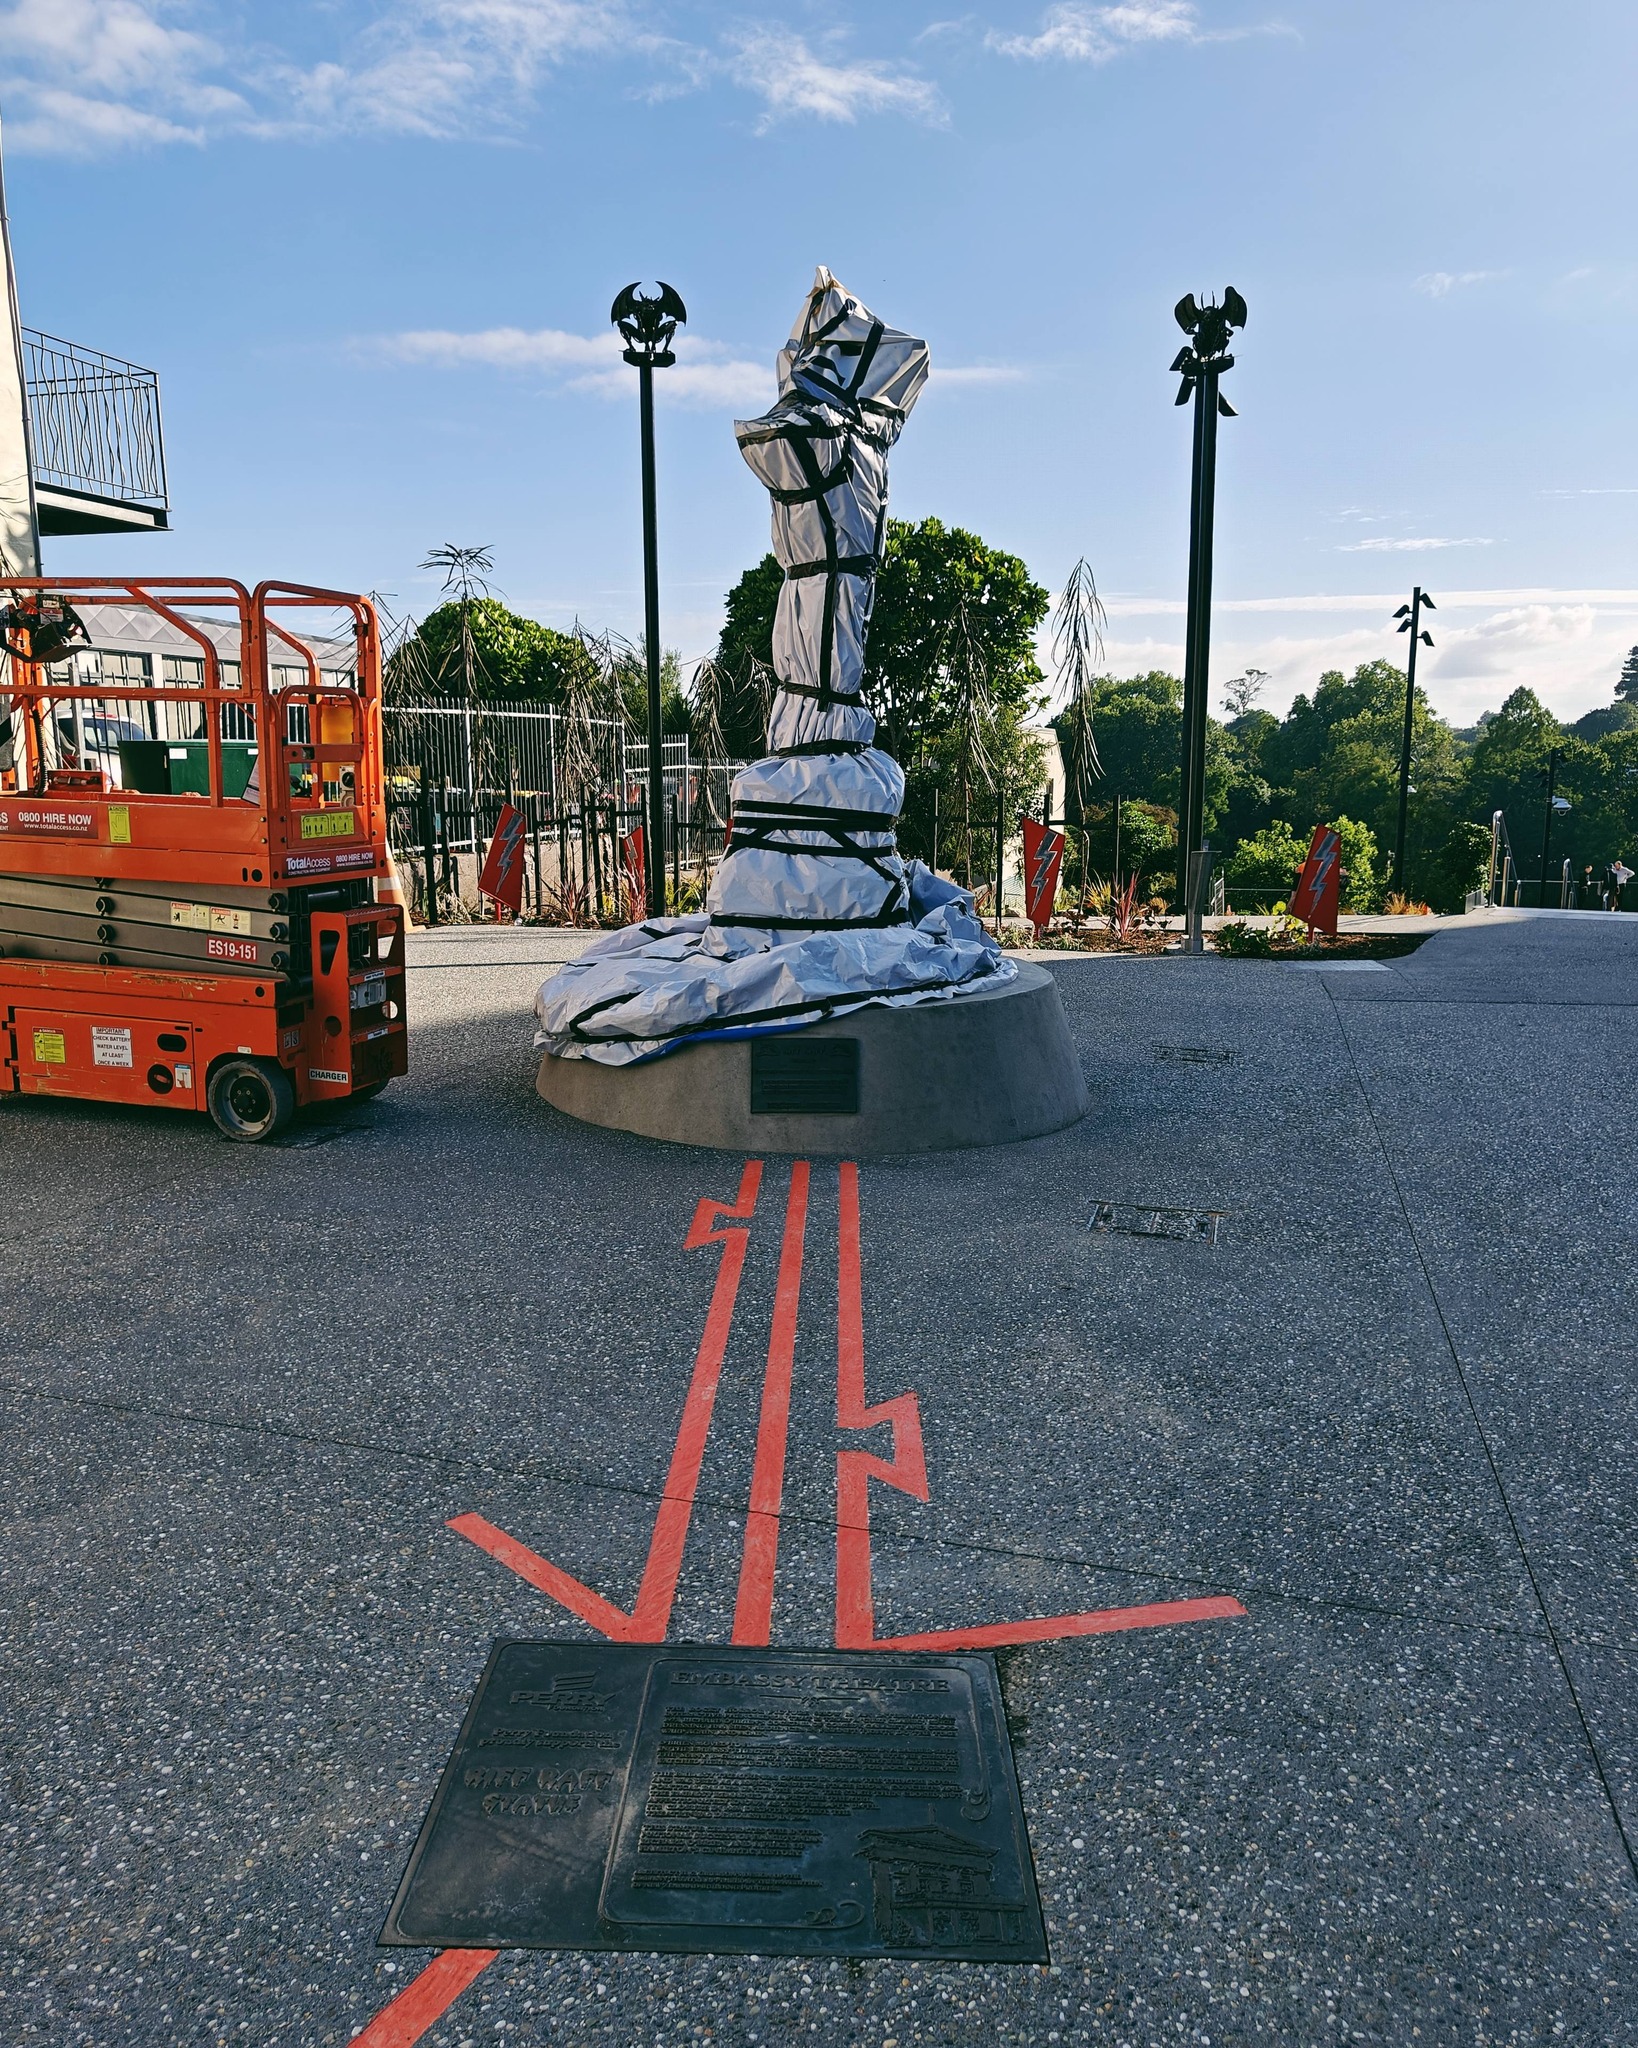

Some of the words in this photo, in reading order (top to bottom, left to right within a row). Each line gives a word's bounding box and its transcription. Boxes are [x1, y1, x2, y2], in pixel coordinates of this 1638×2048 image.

[18, 811, 40, 822] 0800
[42, 813, 66, 823] HIRE
[68, 814, 92, 825] NOW
[24, 822, 88, 832] www.totalaccess.co.nz
[348, 853, 361, 862] HIRE
[361, 852, 374, 860] NOW
[208, 939, 256, 960] ES19-151
[310, 1070, 347, 1081] CHARGER
[671, 1671, 808, 1689] EMBASSY
[811, 1676, 951, 1692] THEATRE
[510, 1690, 617, 1707] PERRY
[492, 1727, 532, 1738] Perry
[534, 1728, 613, 1740] Foundation
[464, 1766, 533, 1789] RIFF
[537, 1767, 615, 1793] RAFF
